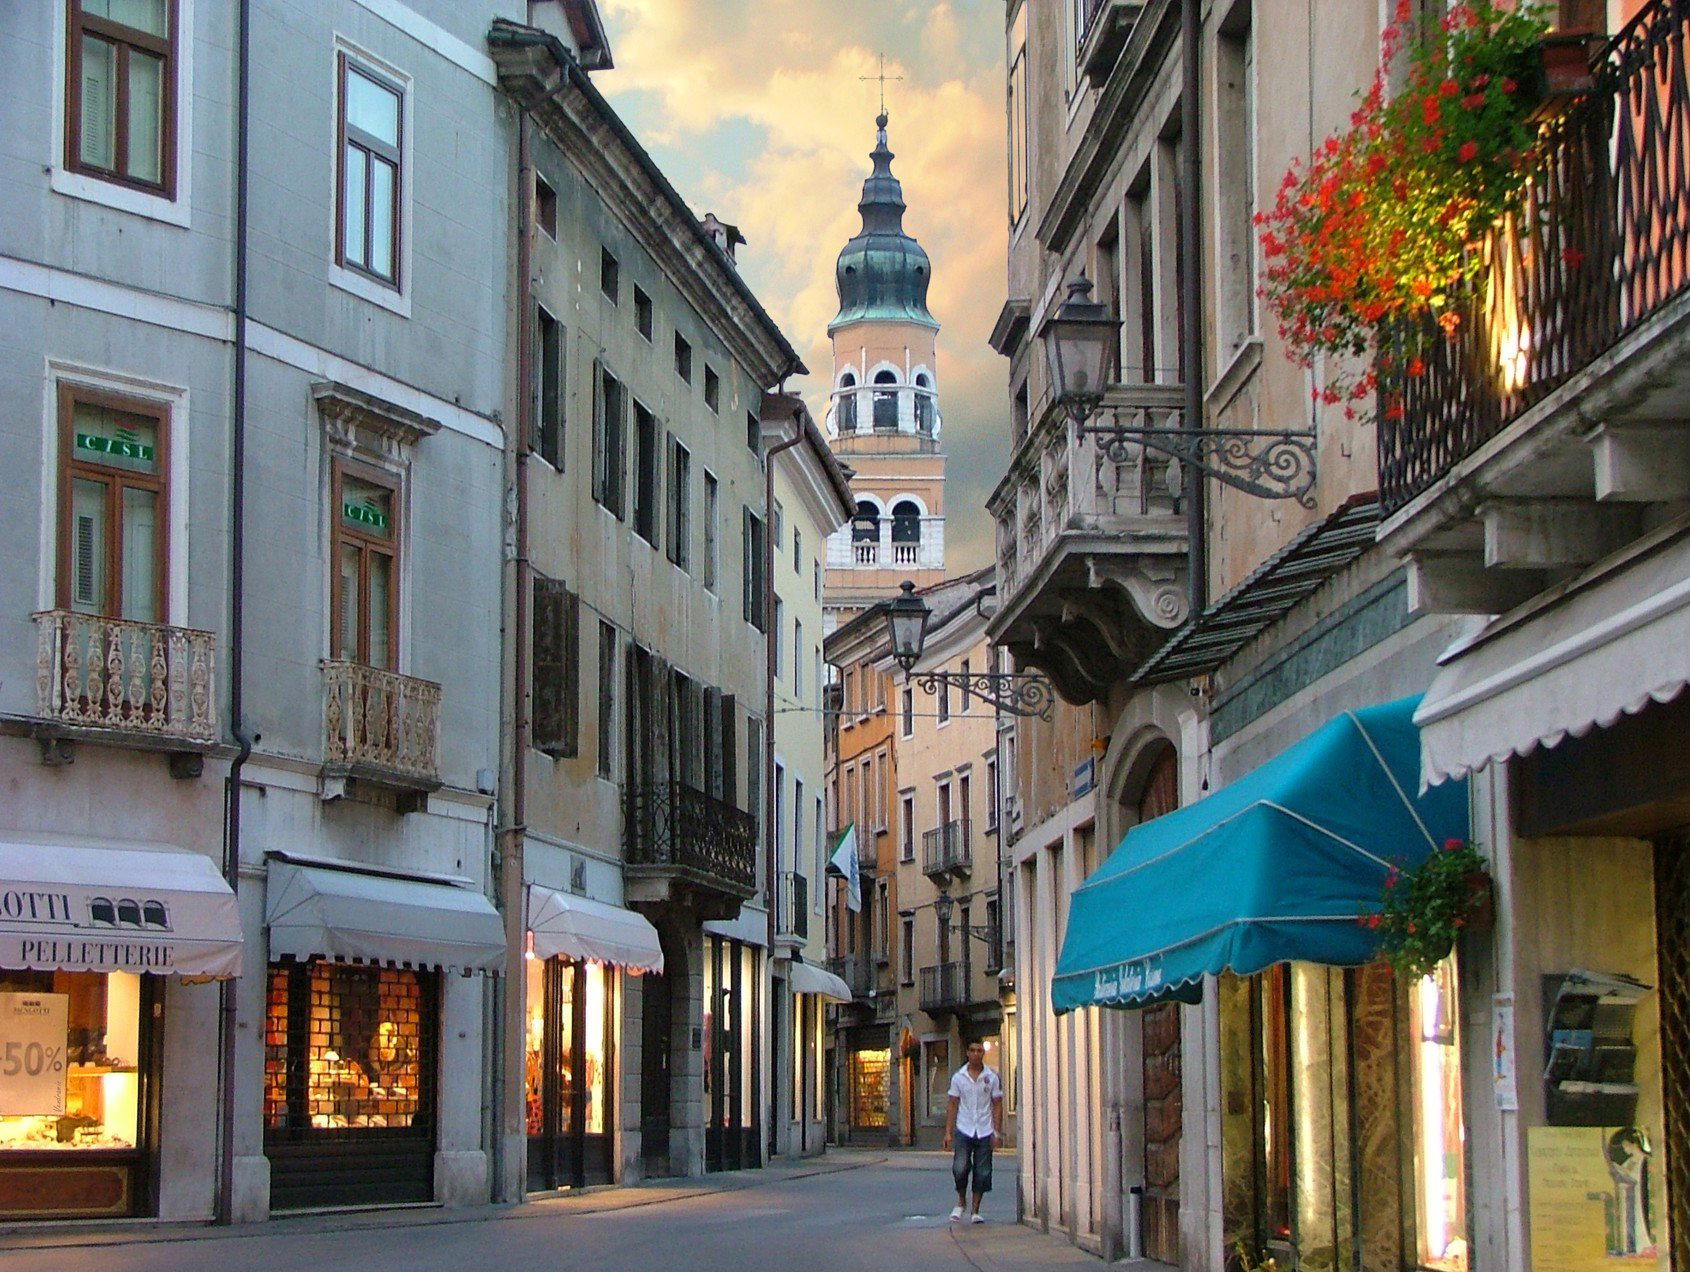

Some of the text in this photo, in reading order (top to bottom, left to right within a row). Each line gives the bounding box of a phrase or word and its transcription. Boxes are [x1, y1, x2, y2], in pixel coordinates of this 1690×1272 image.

[85, 436, 148, 459] CISL
[348, 505, 386, 527] CISL
[0, 891, 71, 920] OTTI
[22, 940, 174, 967] PELLETTERIE
